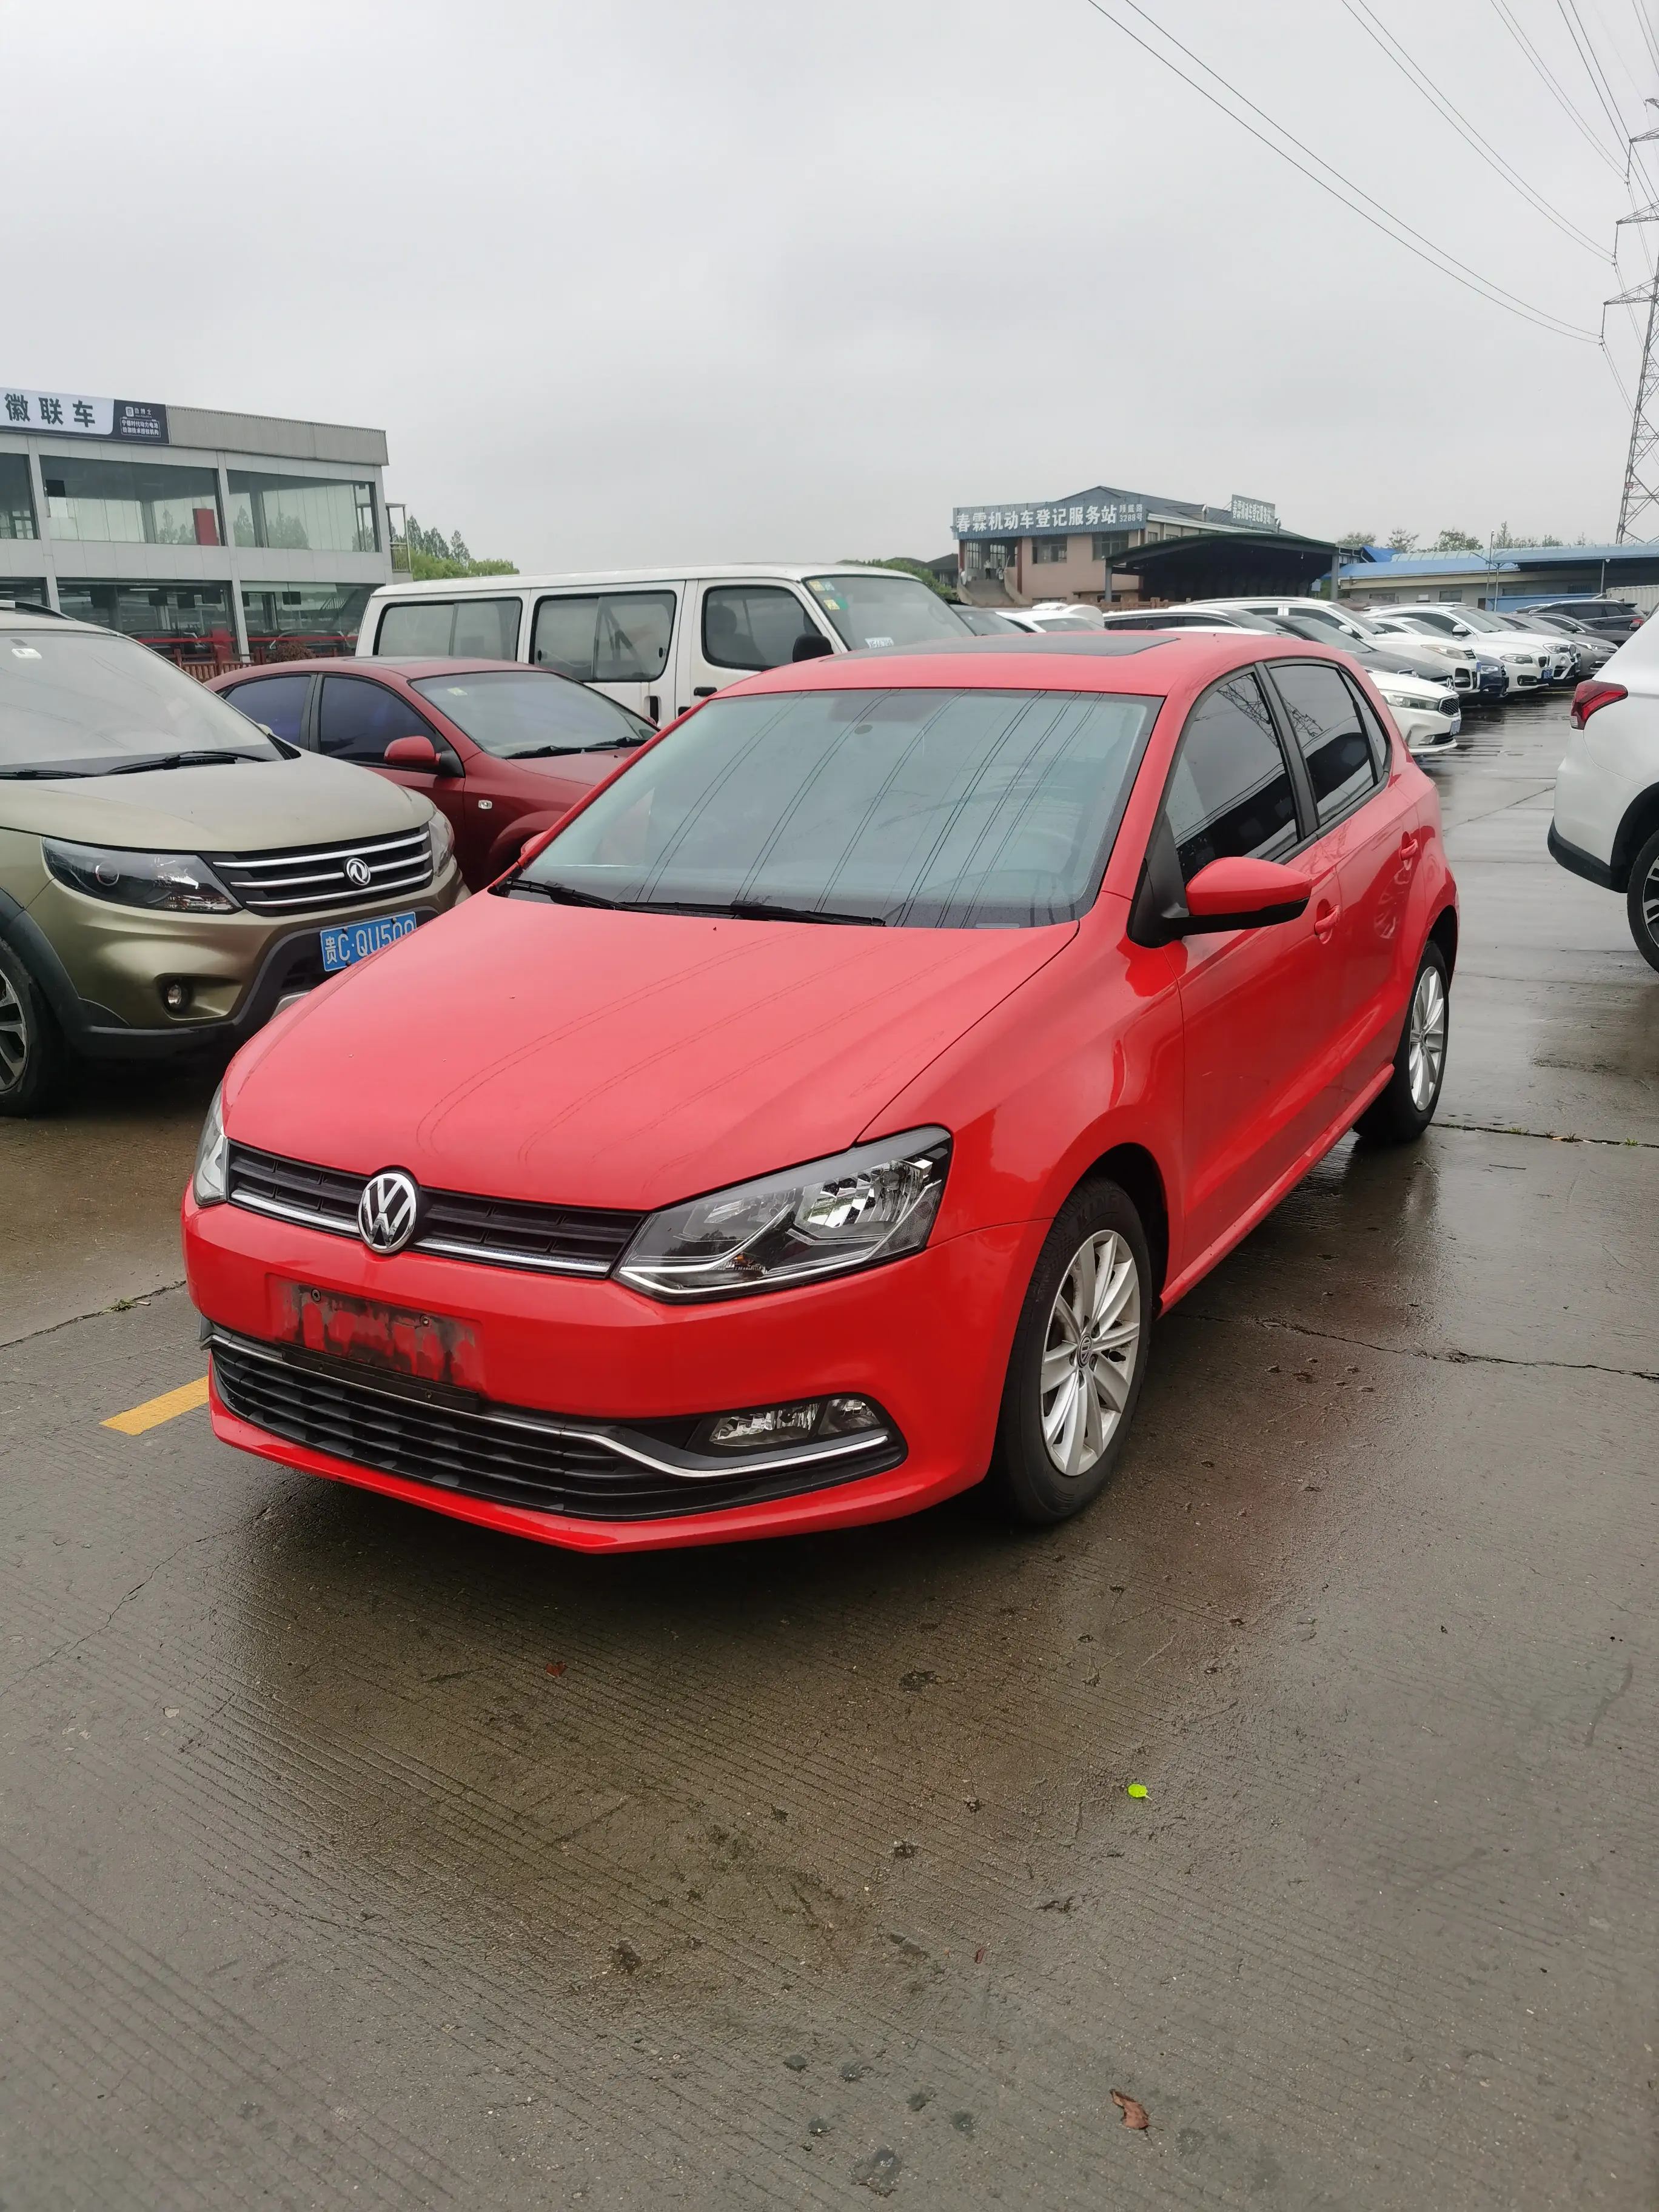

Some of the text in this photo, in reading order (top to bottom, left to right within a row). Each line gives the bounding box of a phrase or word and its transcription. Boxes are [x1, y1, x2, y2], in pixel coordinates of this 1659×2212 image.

[4, 393, 95, 427] 徽联车
[956, 504, 1117, 532] 春霖机动车登记服务站
[1119, 512, 1144, 522] 3288号
